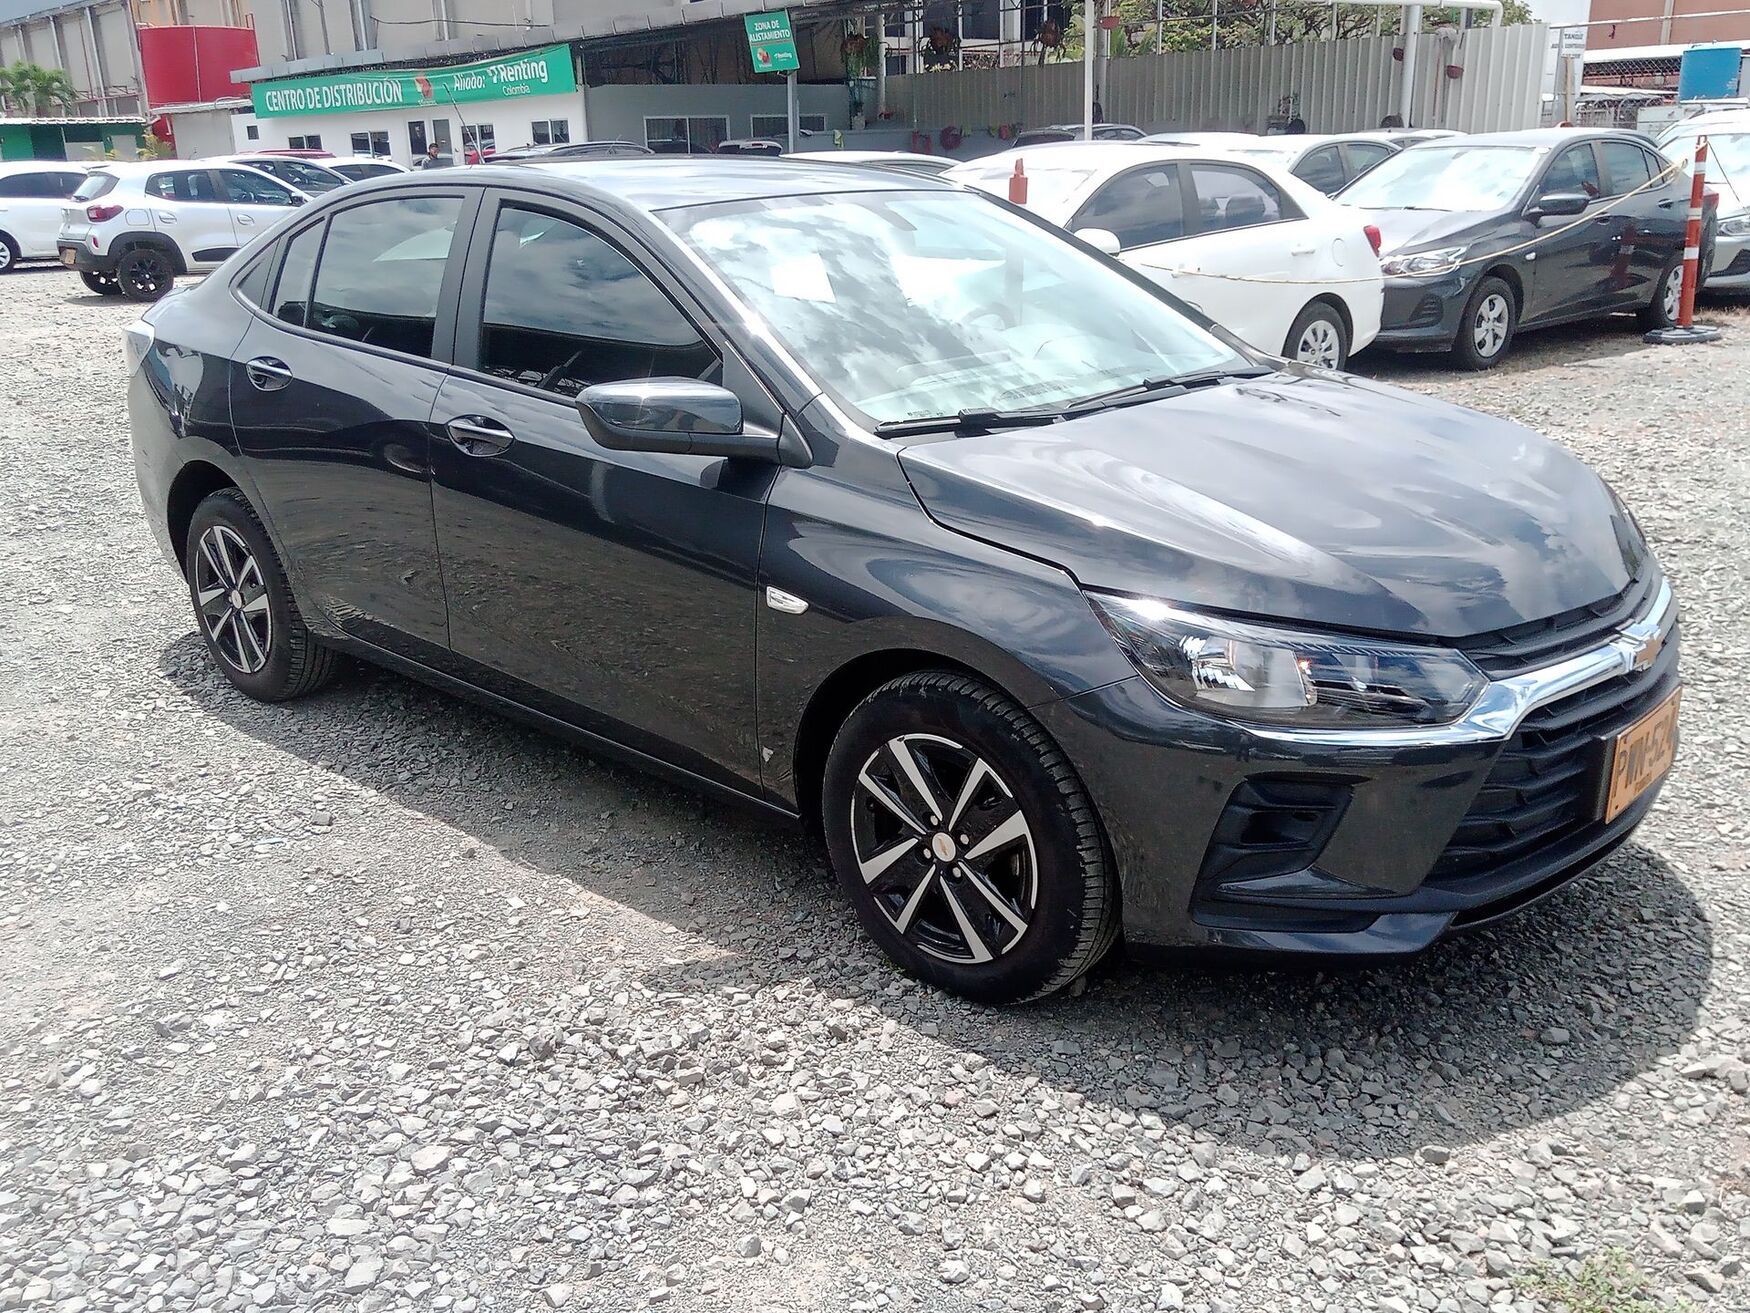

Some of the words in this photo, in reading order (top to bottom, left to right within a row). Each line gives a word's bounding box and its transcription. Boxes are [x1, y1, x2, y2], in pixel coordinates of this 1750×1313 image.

[754, 21, 771, 31] ZONA
[771, 20, 780, 29] DE
[749, 29, 791, 42] ALISTAMIENTO
[453, 71, 486, 91] Aliado:
[500, 59, 548, 83] Renting
[265, 88, 305, 112] CENTRO
[306, 87, 322, 109] DE
[322, 77, 403, 108] DISTRIBUCIÓN
[502, 83, 531, 96] Colombia
